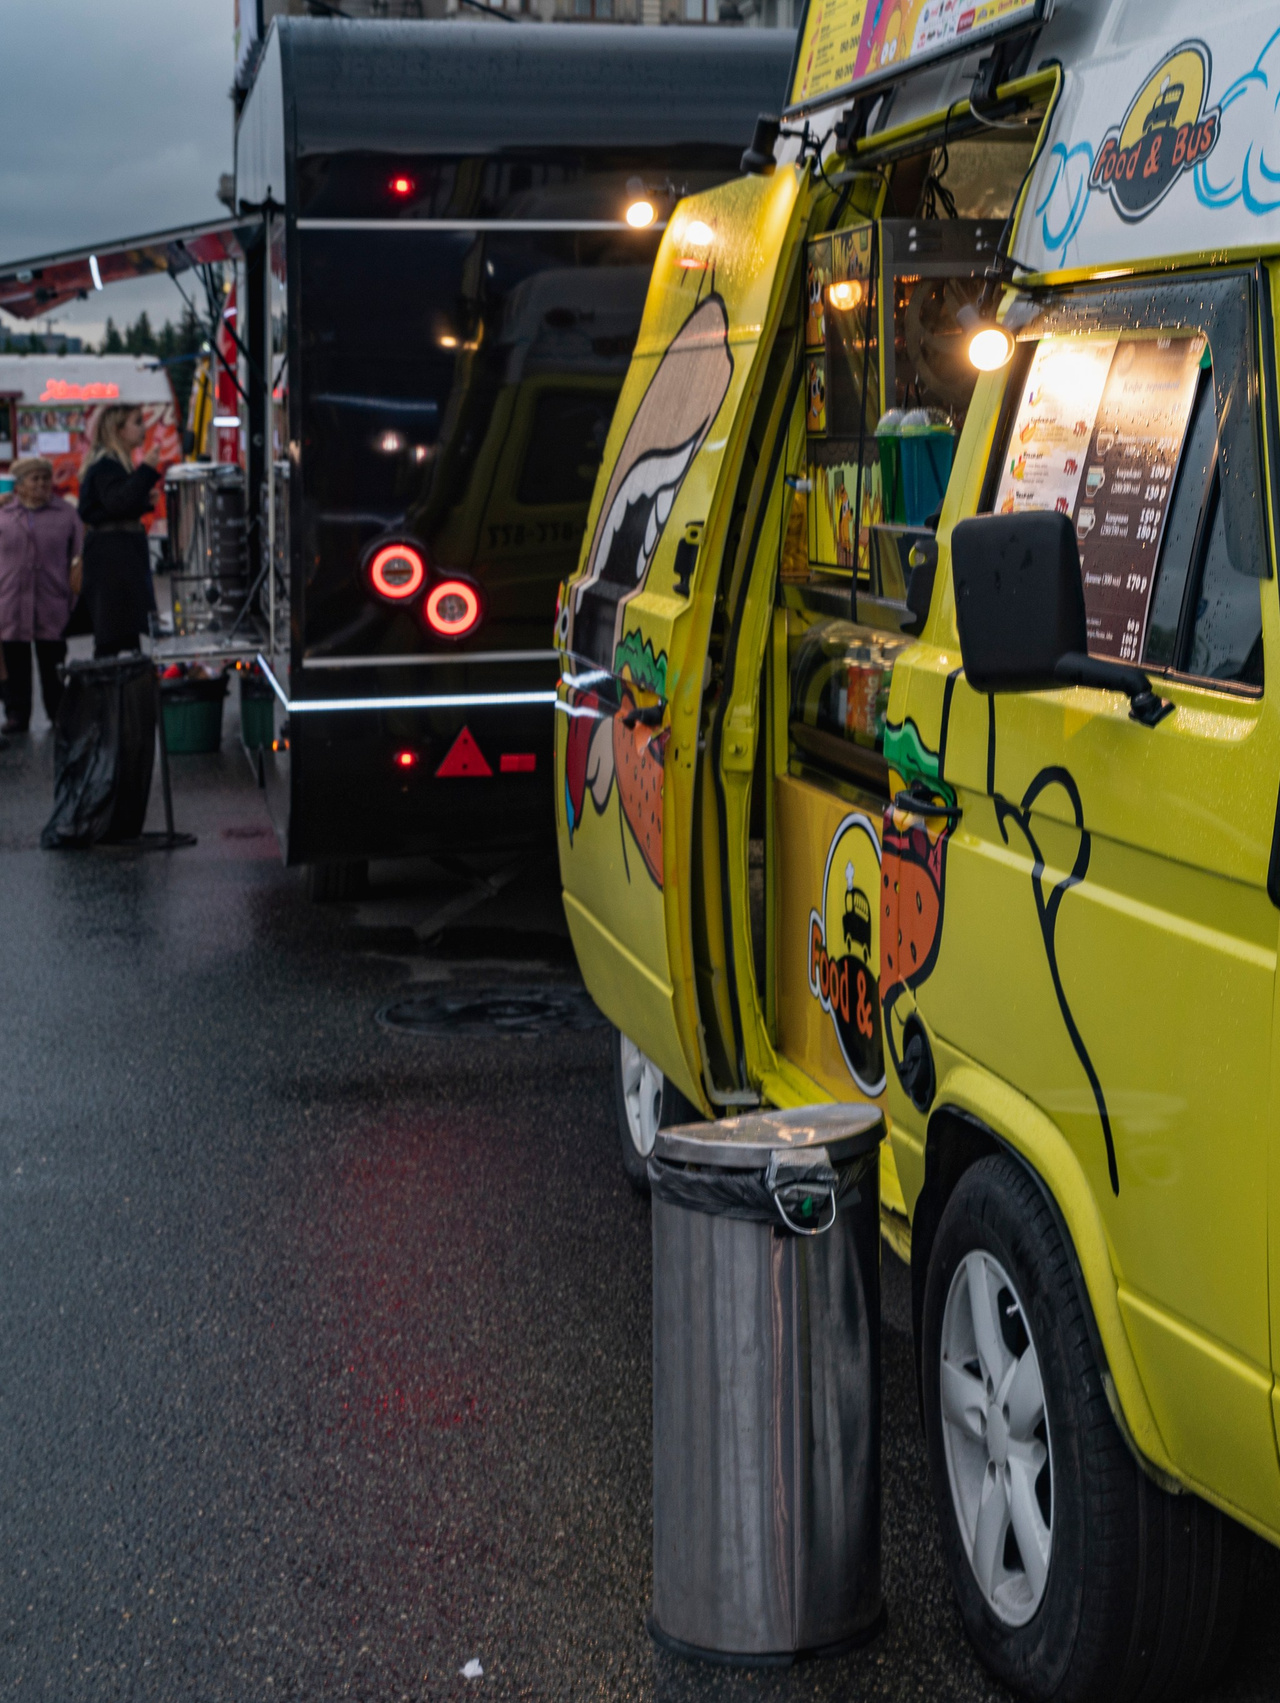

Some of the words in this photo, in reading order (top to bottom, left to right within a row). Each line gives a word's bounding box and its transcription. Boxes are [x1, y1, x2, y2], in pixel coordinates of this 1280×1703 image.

[1094, 138, 1142, 181] Food
[1143, 132, 1163, 179] &
[1171, 117, 1215, 167] Bus
[810, 920, 849, 1024] Food
[855, 968, 874, 1040] &
